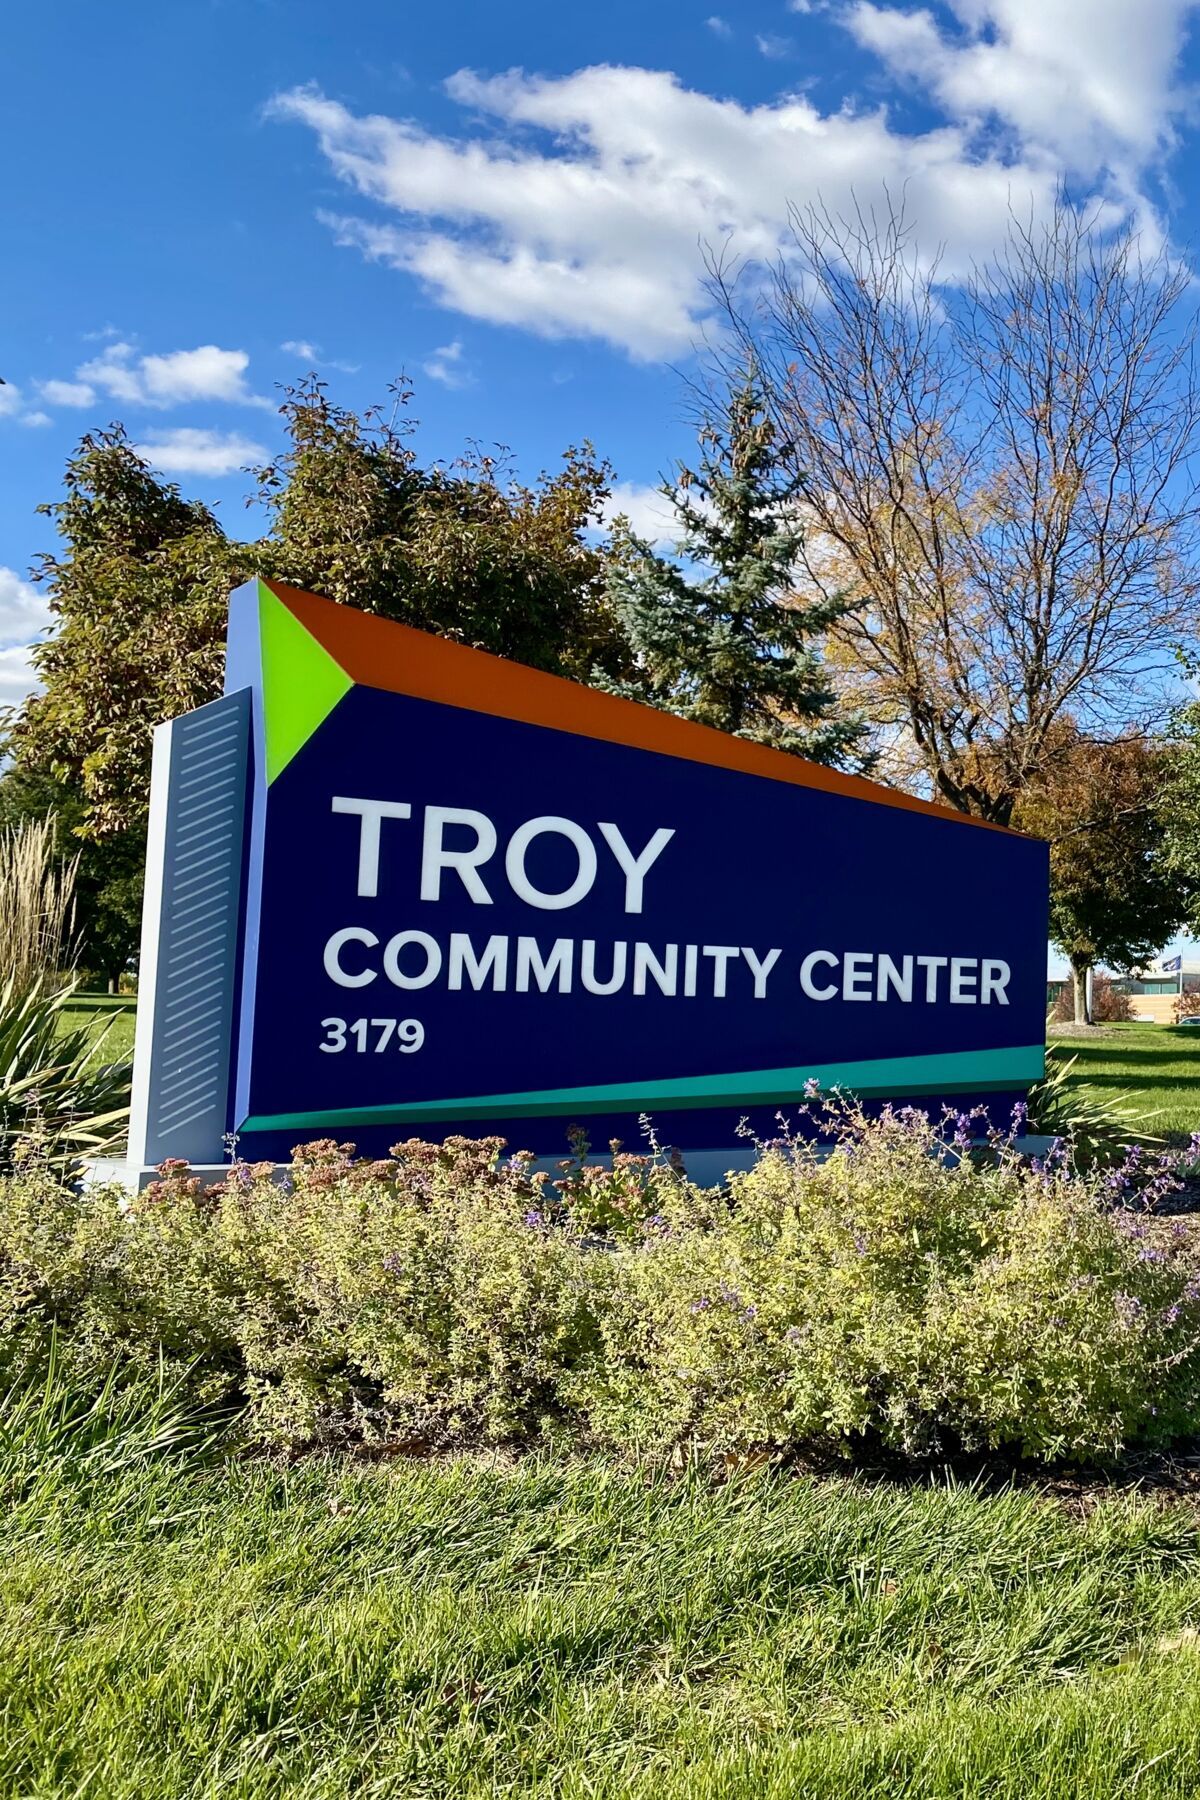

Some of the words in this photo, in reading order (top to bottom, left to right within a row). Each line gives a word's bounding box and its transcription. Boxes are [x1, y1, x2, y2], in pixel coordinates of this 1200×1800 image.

[331, 796, 676, 914] TROY
[323, 926, 783, 999] COMMUNITY
[799, 950, 1012, 1005] CENTER
[319, 1017, 425, 1054] 3179
